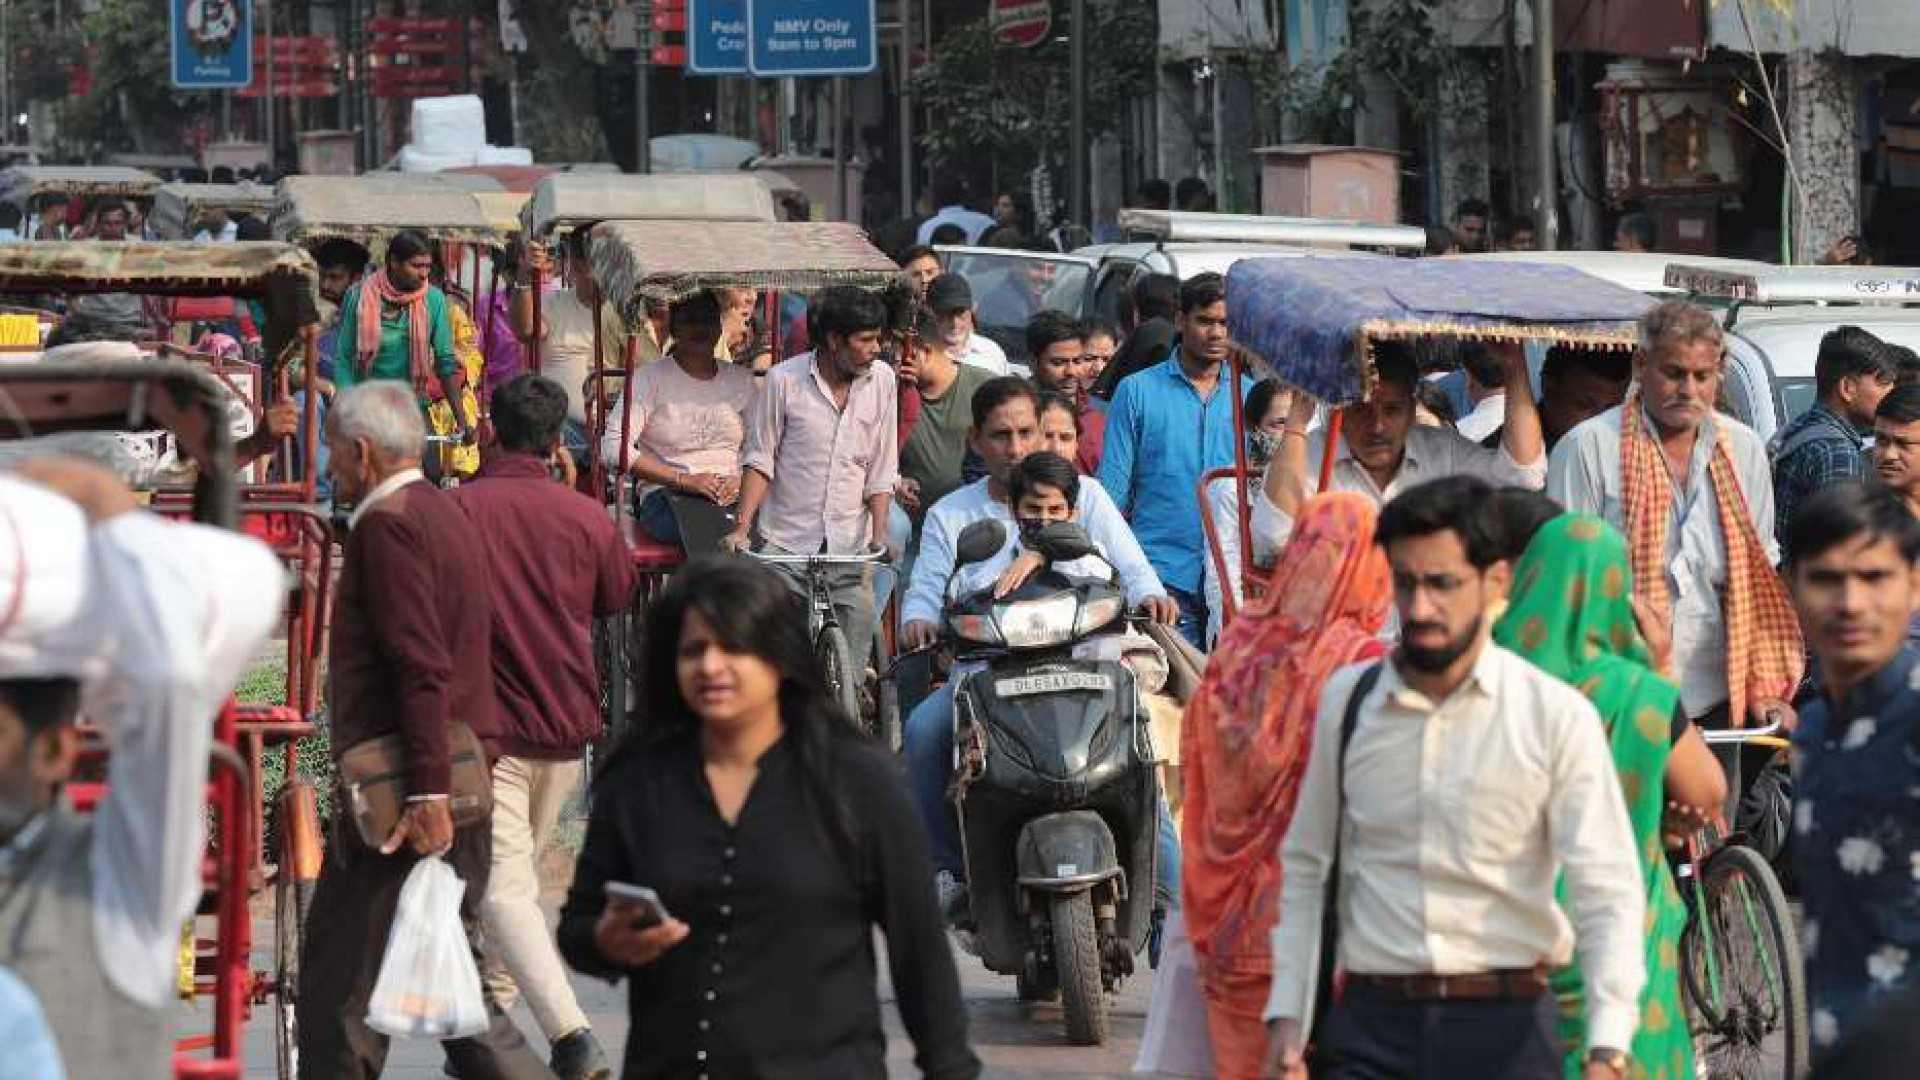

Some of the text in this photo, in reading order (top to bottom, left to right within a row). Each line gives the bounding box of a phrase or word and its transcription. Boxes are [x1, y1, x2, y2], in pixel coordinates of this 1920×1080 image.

[773, 18, 849, 35] NMV Only
[804, 37, 820, 49] to
